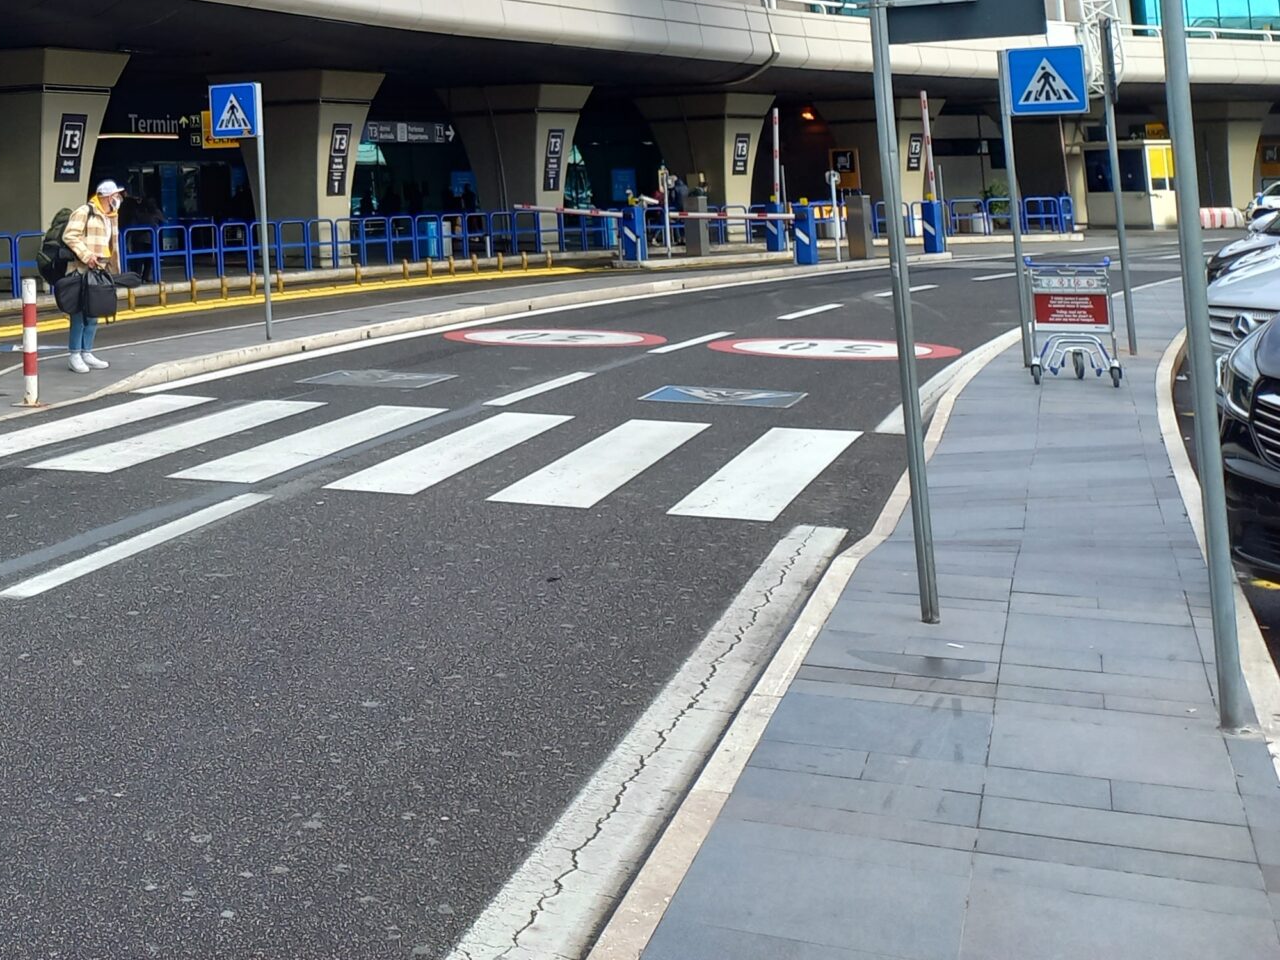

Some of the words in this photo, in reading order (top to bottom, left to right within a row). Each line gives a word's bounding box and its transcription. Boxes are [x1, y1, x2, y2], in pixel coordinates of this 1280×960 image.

[368, 126, 378, 138] T3
[65, 129, 80, 149] T3
[335, 134, 348, 150] T3
[550, 138, 561, 151] T3
[737, 142, 747, 155] T3
[333, 180, 339, 194] 1
